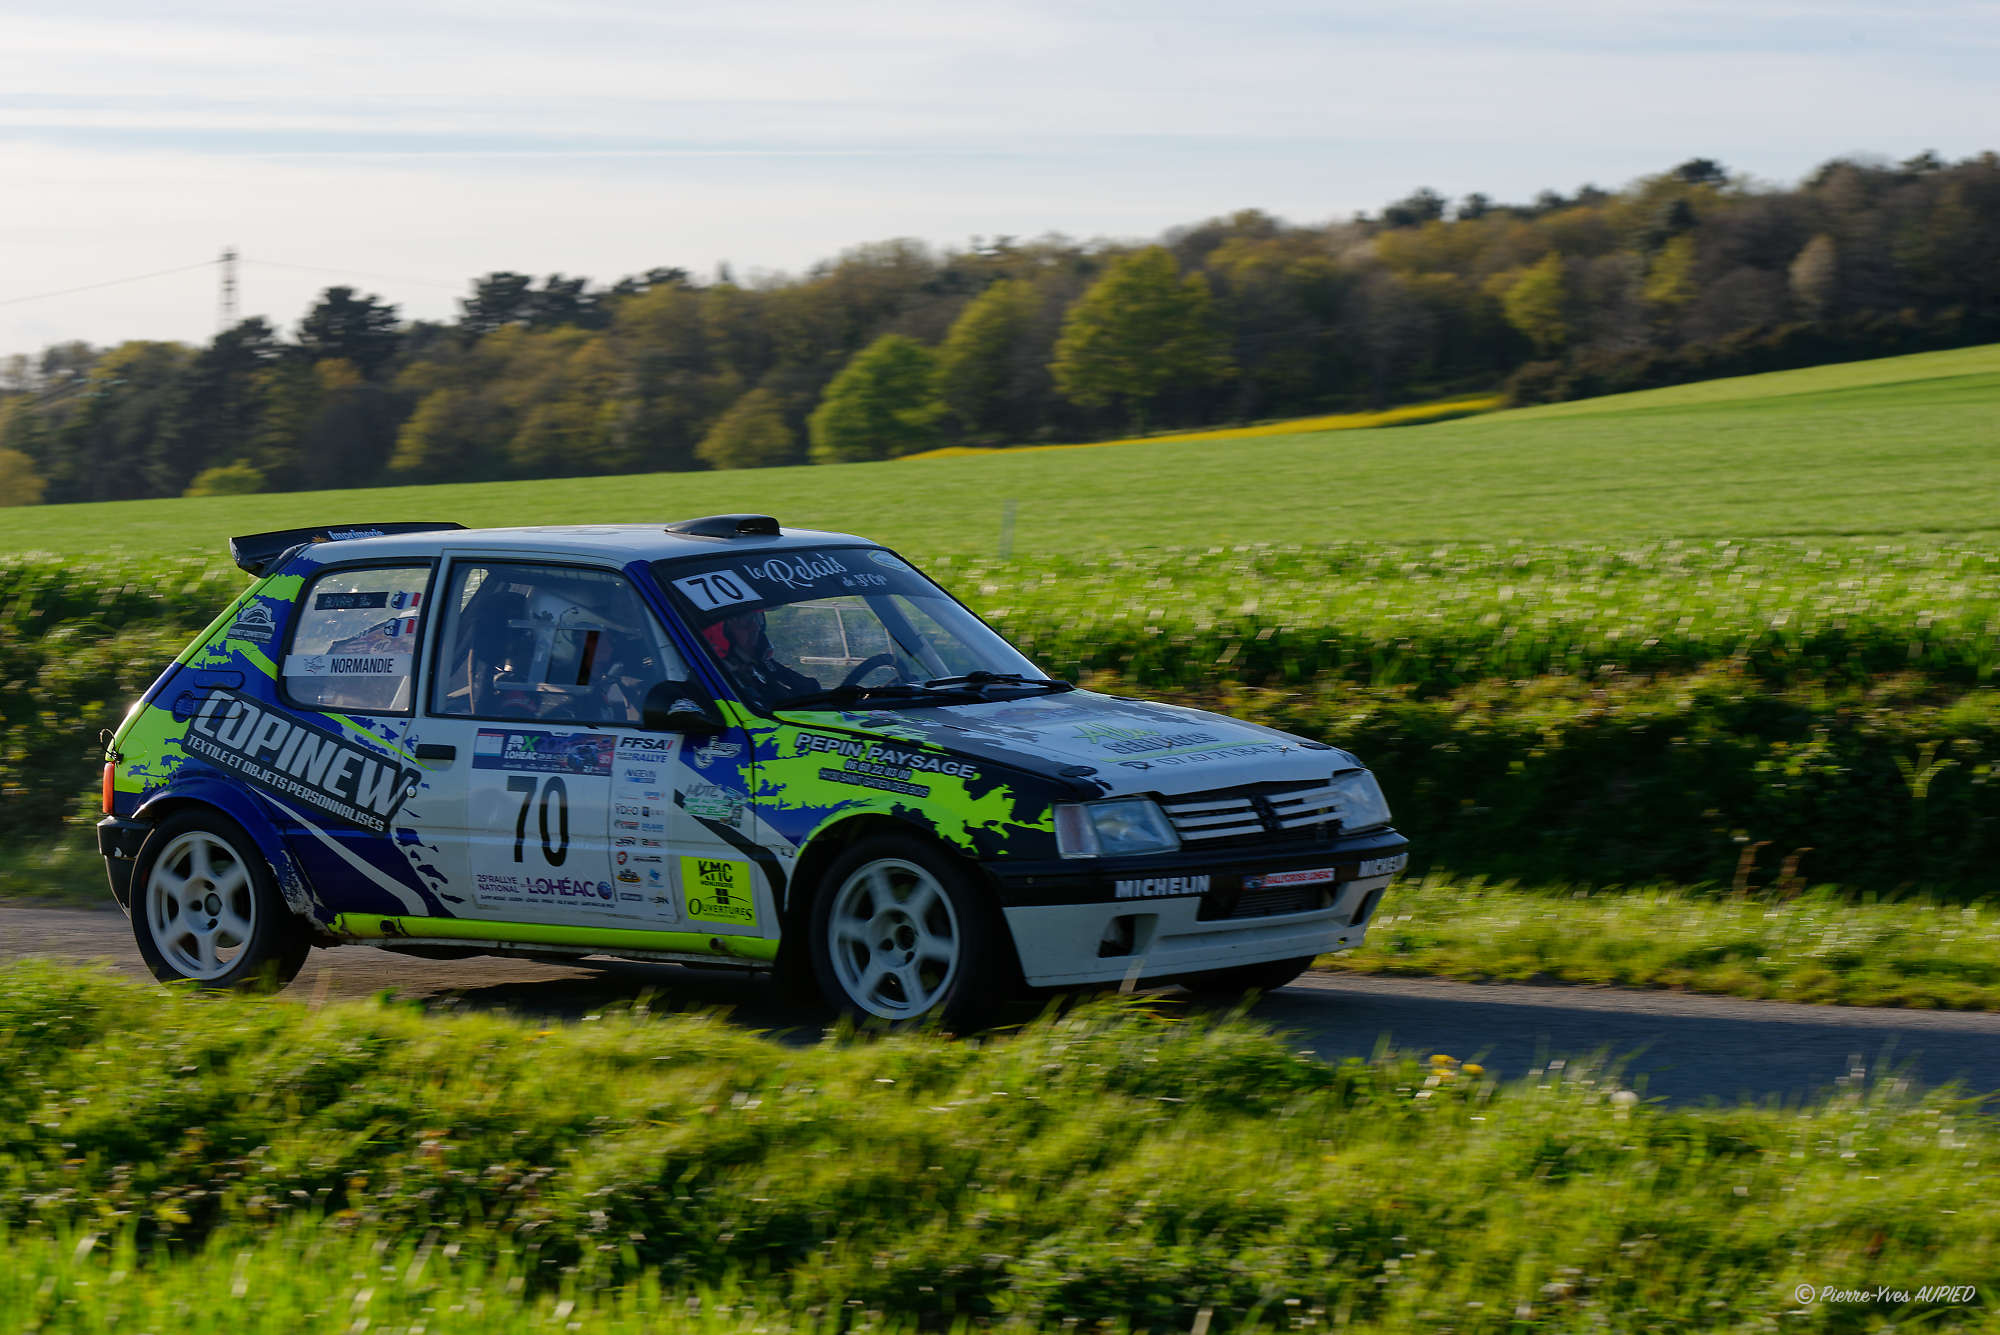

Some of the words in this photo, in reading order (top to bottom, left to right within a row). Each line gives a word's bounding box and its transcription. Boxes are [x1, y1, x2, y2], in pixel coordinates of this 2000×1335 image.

[327, 529, 384, 541] Imprimerie
[763, 554, 847, 589] Relais
[686, 574, 744, 604] 70
[330, 658, 394, 673] NORMANDIE
[193, 690, 413, 817] COPINEW
[620, 736, 666, 750] FFSA
[632, 752, 668, 763] RALLYE
[794, 733, 863, 757] PEPIN
[866, 746, 977, 779] PAYSAGE
[187, 734, 227, 762] TEXTILE
[226, 753, 242, 768] ET
[242, 762, 287, 790] OBJETS
[287, 781, 385, 832] PERSONNALISÉS
[507, 775, 569, 867] 70
[698, 860, 733, 883] KMC
[478, 884, 520, 894] NATIONAL
[526, 877, 597, 898] LOHÉAC
[1114, 875, 1210, 898] MICHELIN
[689, 898, 753, 921] OUVERTURES
